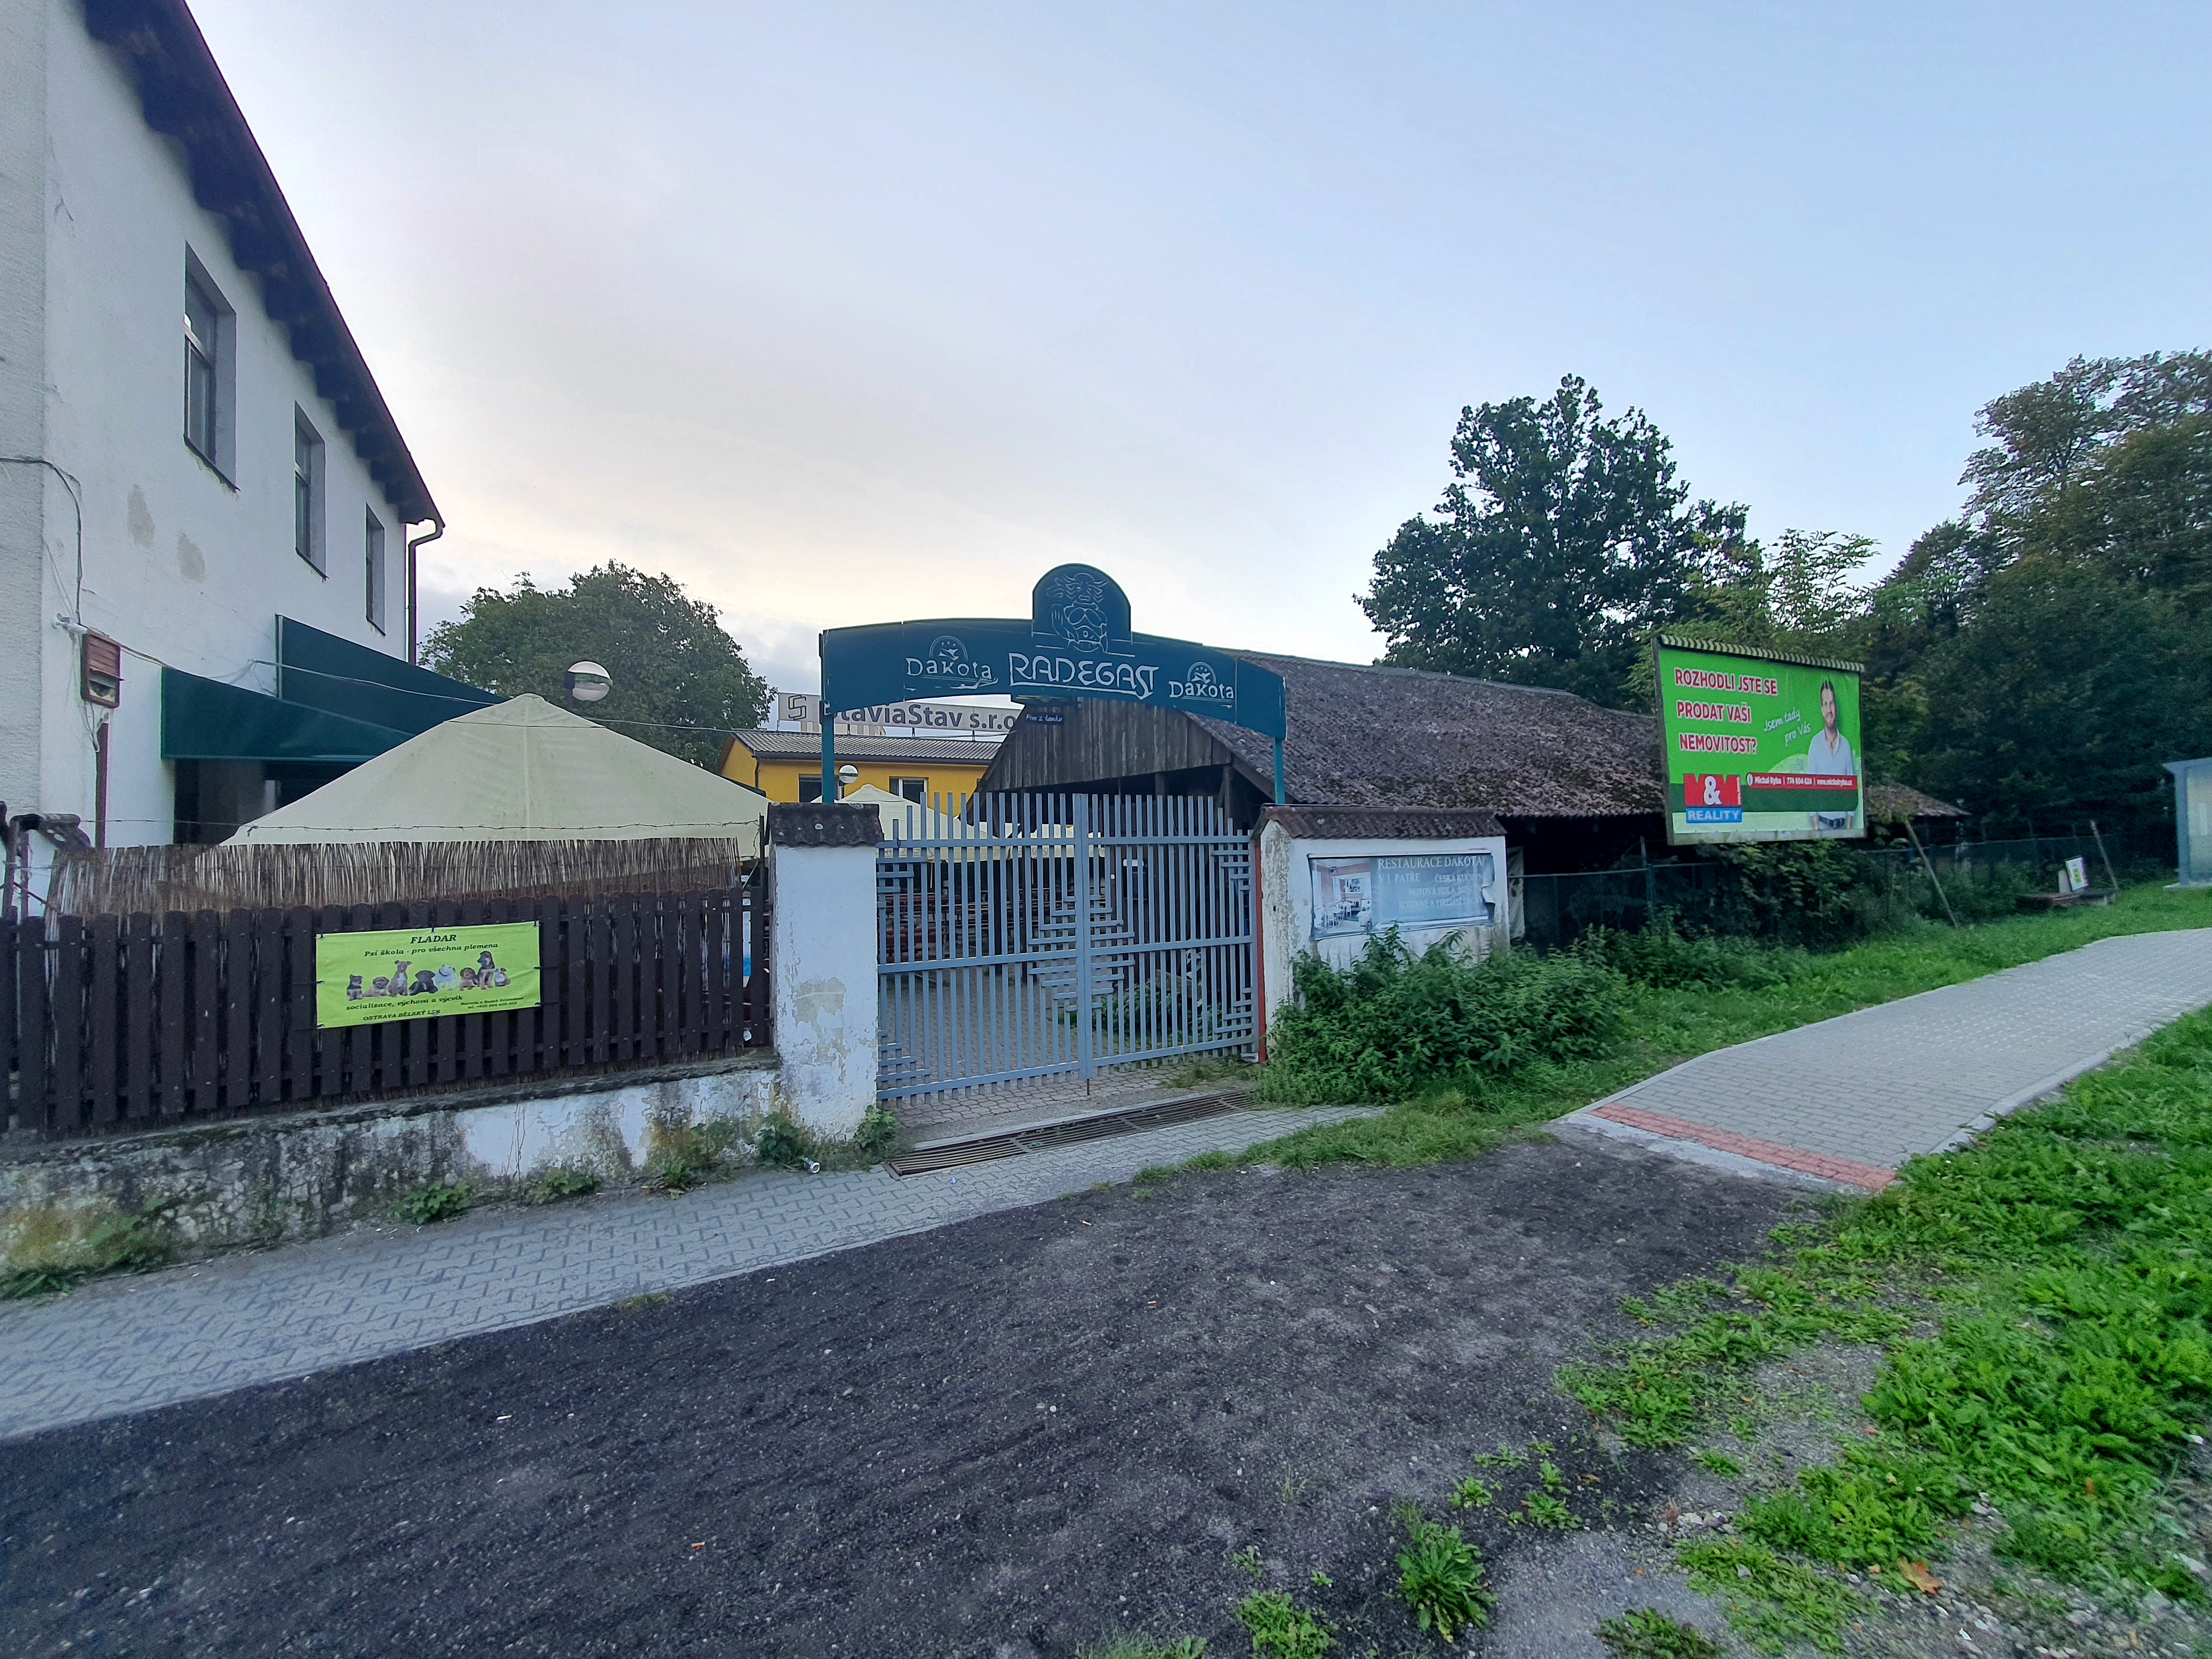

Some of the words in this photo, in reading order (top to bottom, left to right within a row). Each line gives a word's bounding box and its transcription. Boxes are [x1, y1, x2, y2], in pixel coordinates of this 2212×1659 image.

[1009, 653, 1159, 700] RADEGAST
[1675, 668, 1735, 690] ROZHODLI
[1738, 676, 1762, 693] JSTE
[1764, 679, 1778, 695] SE
[1168, 680, 1235, 699] Dakota
[1677, 701, 1724, 720] PRODAT
[1726, 703, 1751, 722] VAŠI
[1764, 717, 1783, 732] Jsem
[1784, 707, 1801, 722] tady
[1680, 733, 1757, 754] NEMOVITOST?
[1784, 730, 1796, 747] pro
[1797, 721, 1811, 735] Vás
[1683, 773, 1742, 806] M&M
[1688, 810, 1740, 820] REALITY
[1378, 857, 1443, 869] RESTAURACE
[1444, 856, 1483, 867] DAKOTA
[1395, 871, 1420, 882] PATŘE
[1435, 873, 1456, 882] ČESKÁ
[410, 934, 457, 944] FLADAR
[346, 1002, 395, 1010] socializace,
[397, 998, 429, 1007] výchova
